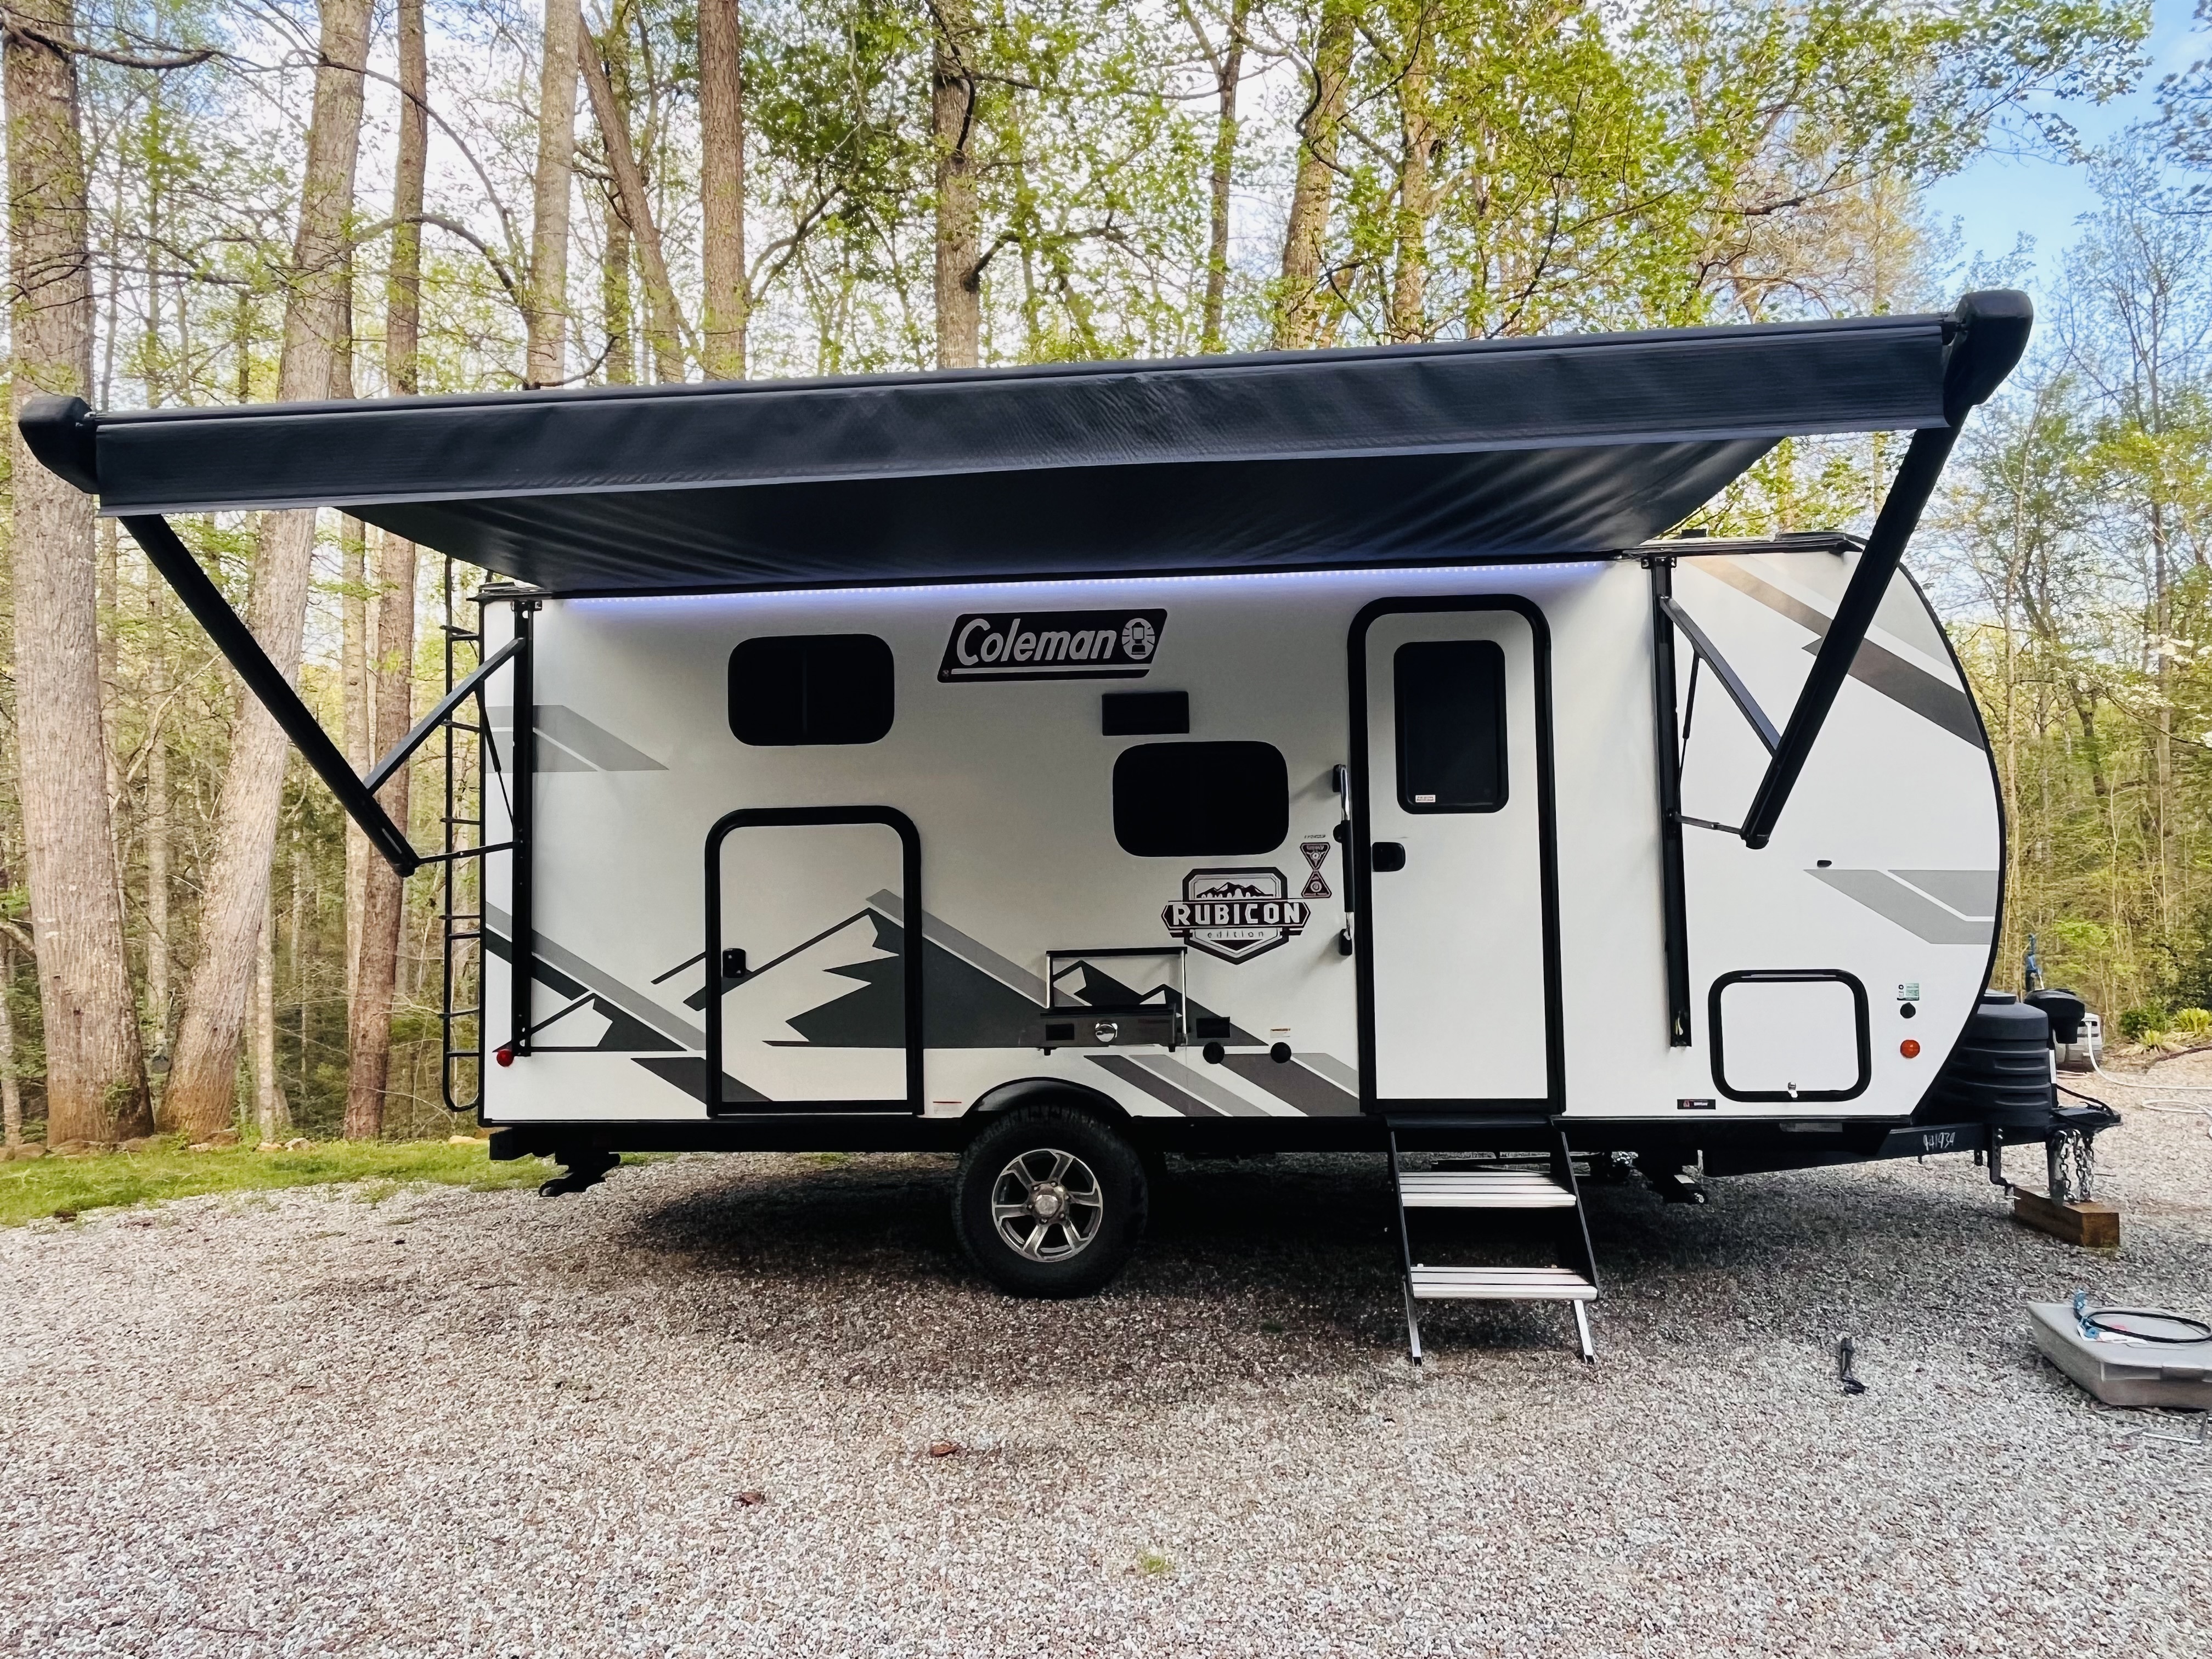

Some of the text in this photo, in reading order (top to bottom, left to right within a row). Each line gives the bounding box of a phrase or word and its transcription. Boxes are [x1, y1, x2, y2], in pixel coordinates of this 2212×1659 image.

[956, 618, 1117, 665] Coleman
[1172, 902, 1300, 926] RUBICON
[1207, 930, 1264, 939] edition
